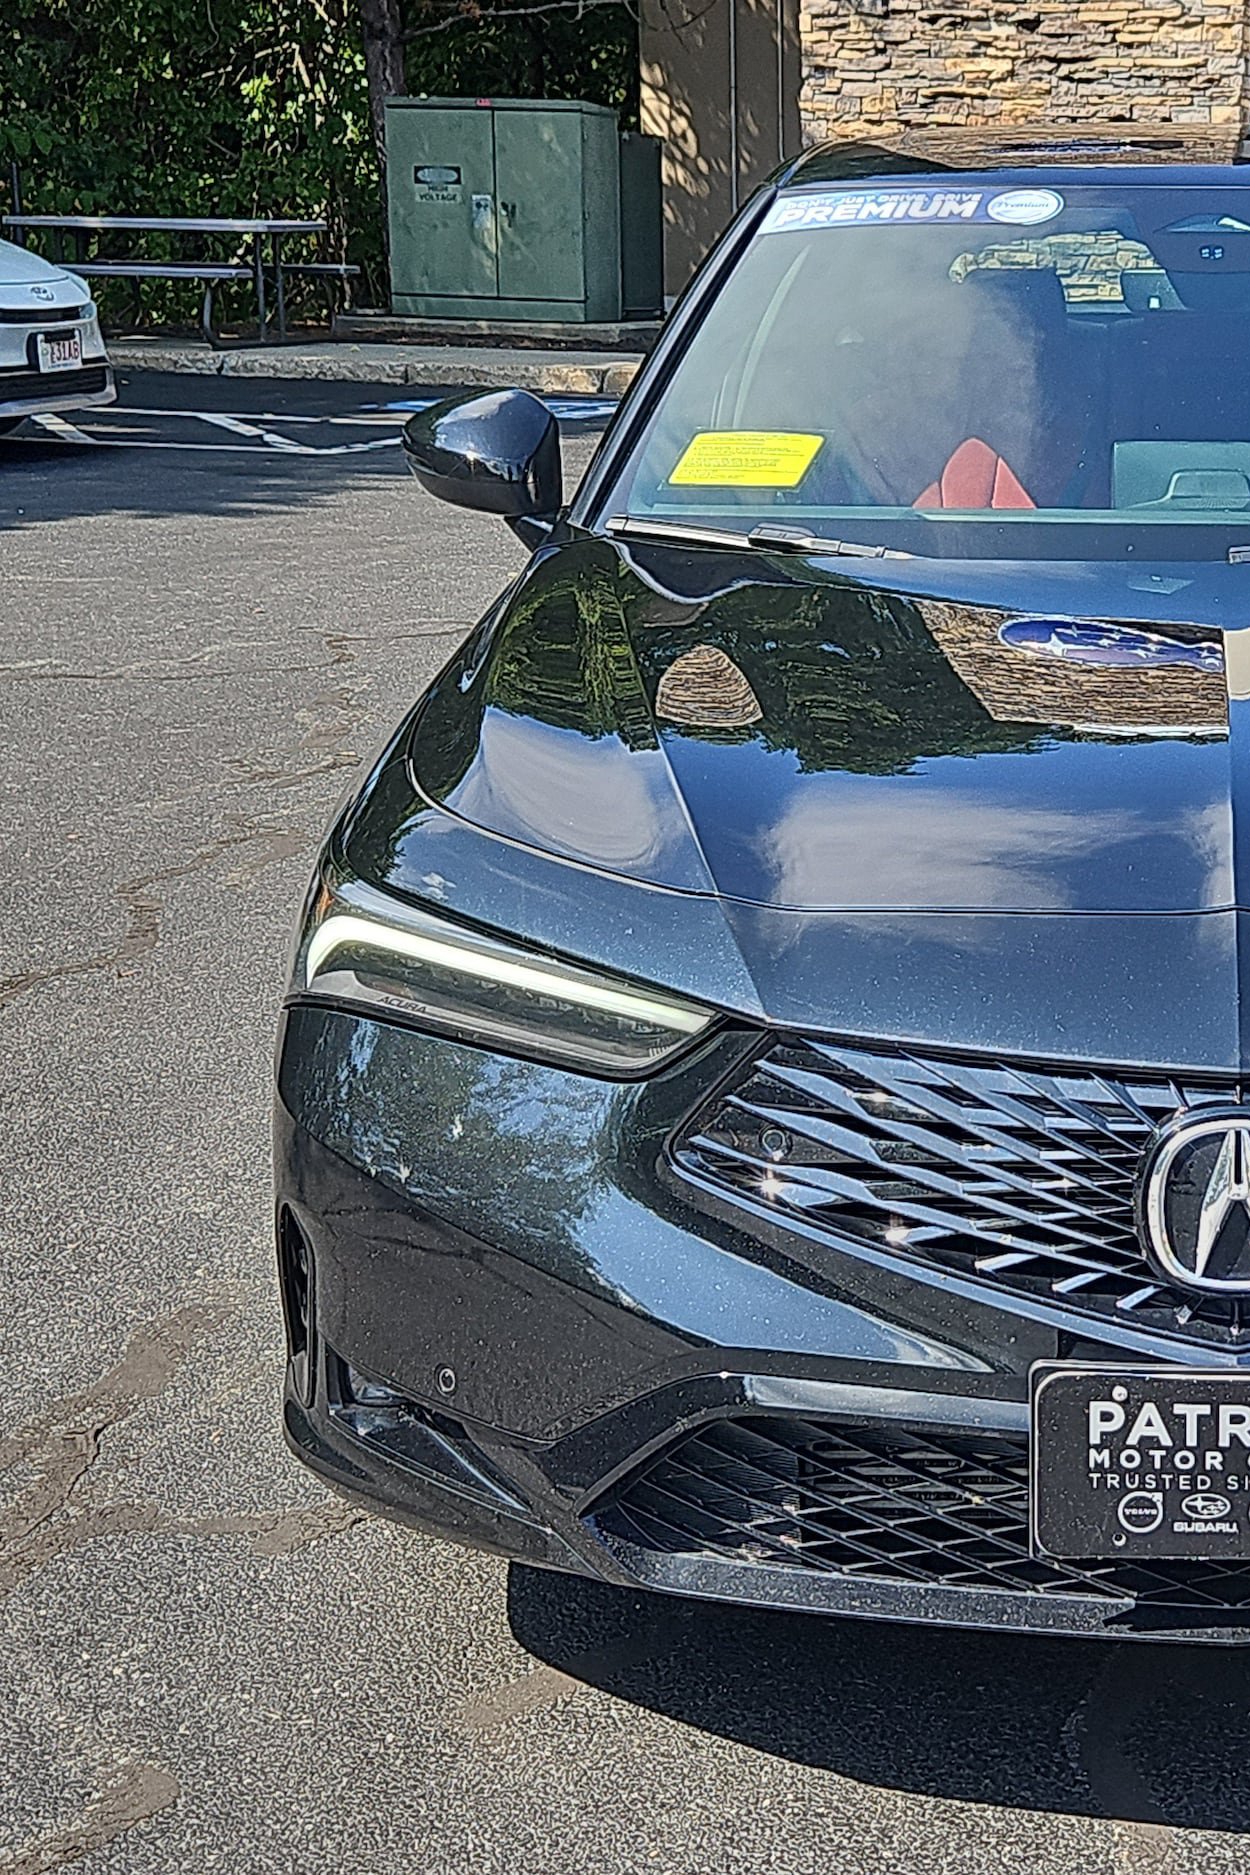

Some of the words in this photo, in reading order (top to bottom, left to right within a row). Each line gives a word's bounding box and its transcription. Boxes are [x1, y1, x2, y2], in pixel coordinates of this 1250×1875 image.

[836, 195, 877, 204] JUST
[775, 199, 980, 226] PREMIUM
[377, 995, 427, 1013] ACURA
[1088, 1448, 1224, 1471] MOTOR
[1088, 1473, 1212, 1490] TRUSTED
[1173, 1521, 1238, 1532] SUBARU
